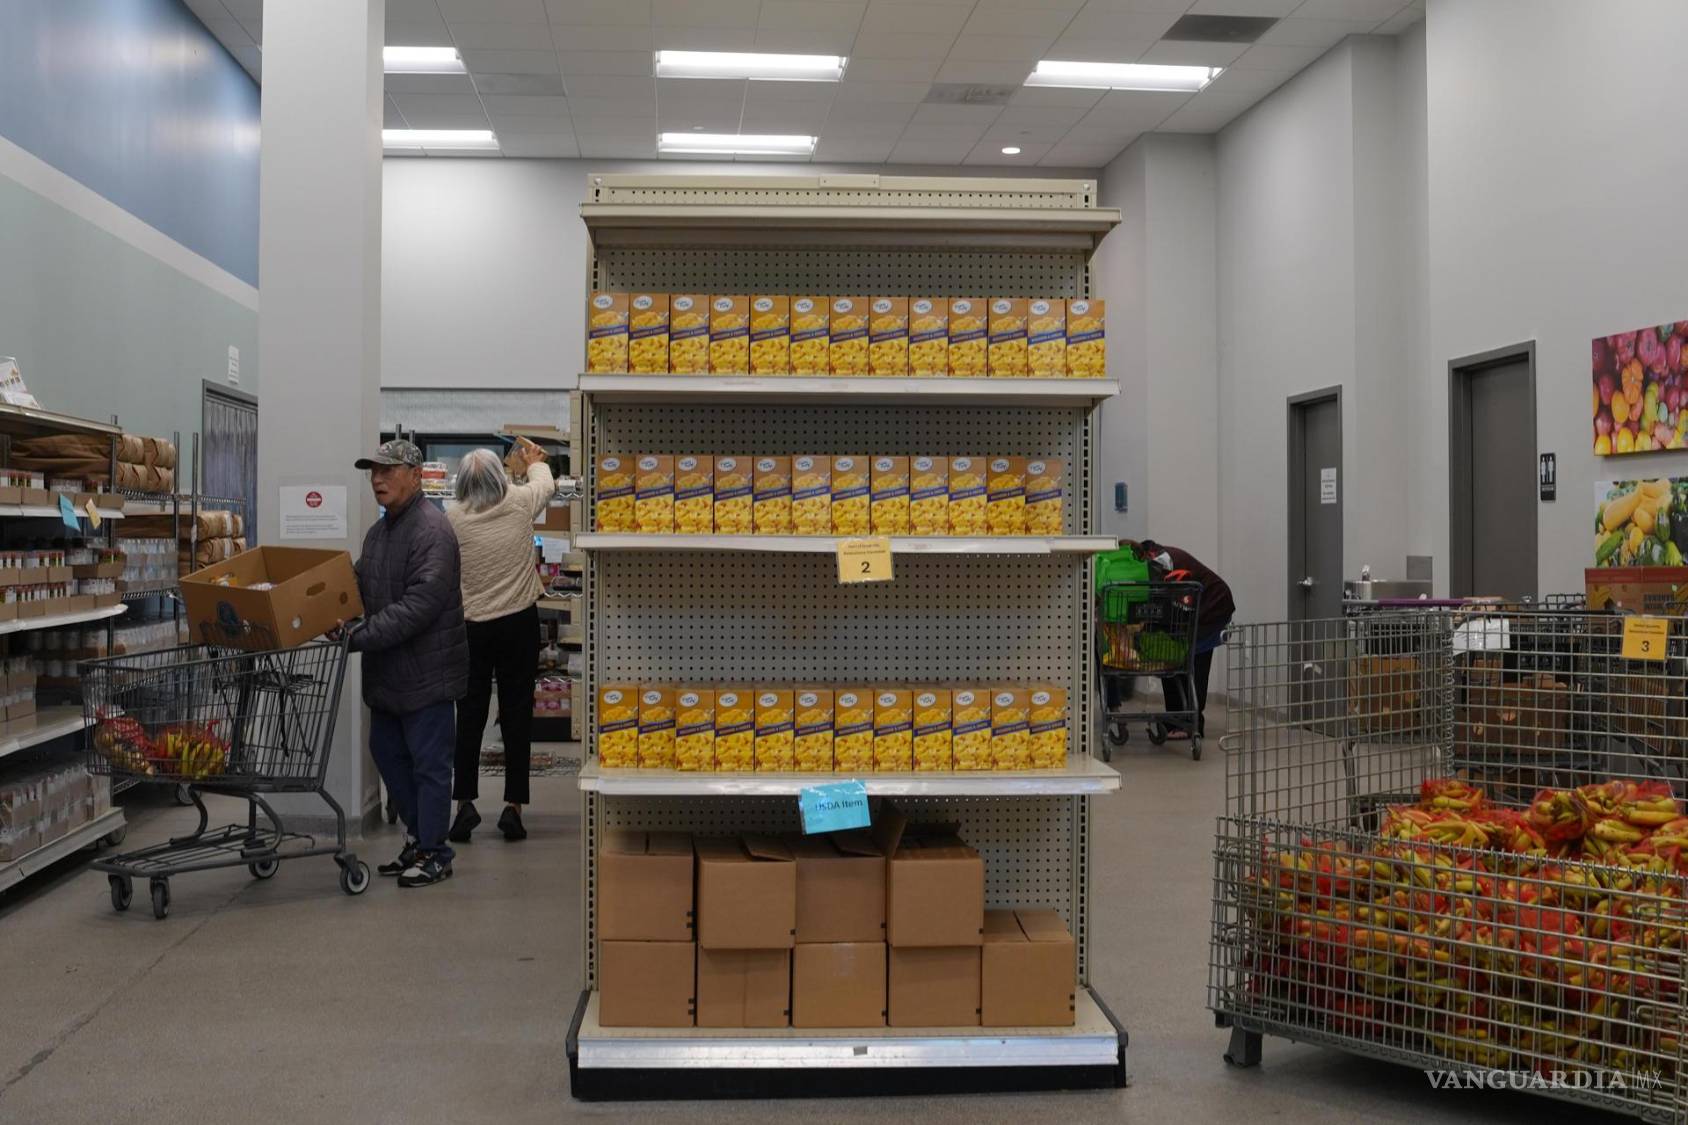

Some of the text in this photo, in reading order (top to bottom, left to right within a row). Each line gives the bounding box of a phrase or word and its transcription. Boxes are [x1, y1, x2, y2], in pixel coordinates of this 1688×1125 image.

[861, 561, 871, 573] 2
[1641, 640, 1650, 652] 3
[815, 799, 863, 811] USDA Item
